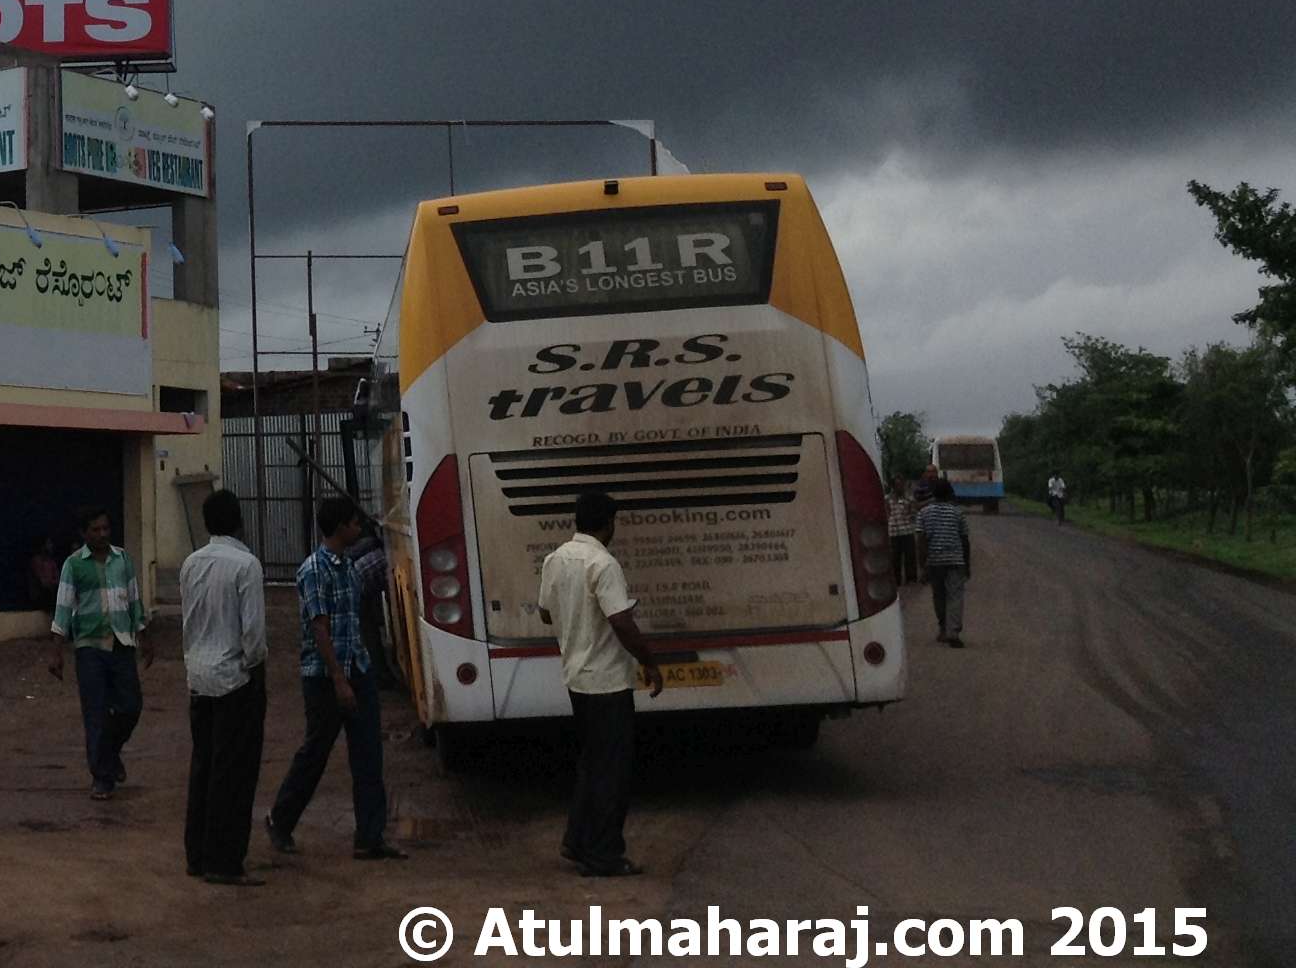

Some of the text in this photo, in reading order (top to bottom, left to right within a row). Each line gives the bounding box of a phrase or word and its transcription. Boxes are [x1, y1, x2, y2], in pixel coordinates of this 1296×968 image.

[512, 266, 737, 297] ASIA'S LONGEST BUS
[527, 333, 742, 374] S.R.S.
[488, 372, 795, 421] travels
[609, 430, 626, 442] BY
[687, 426, 706, 438] OF
[715, 423, 761, 437] INDIA
